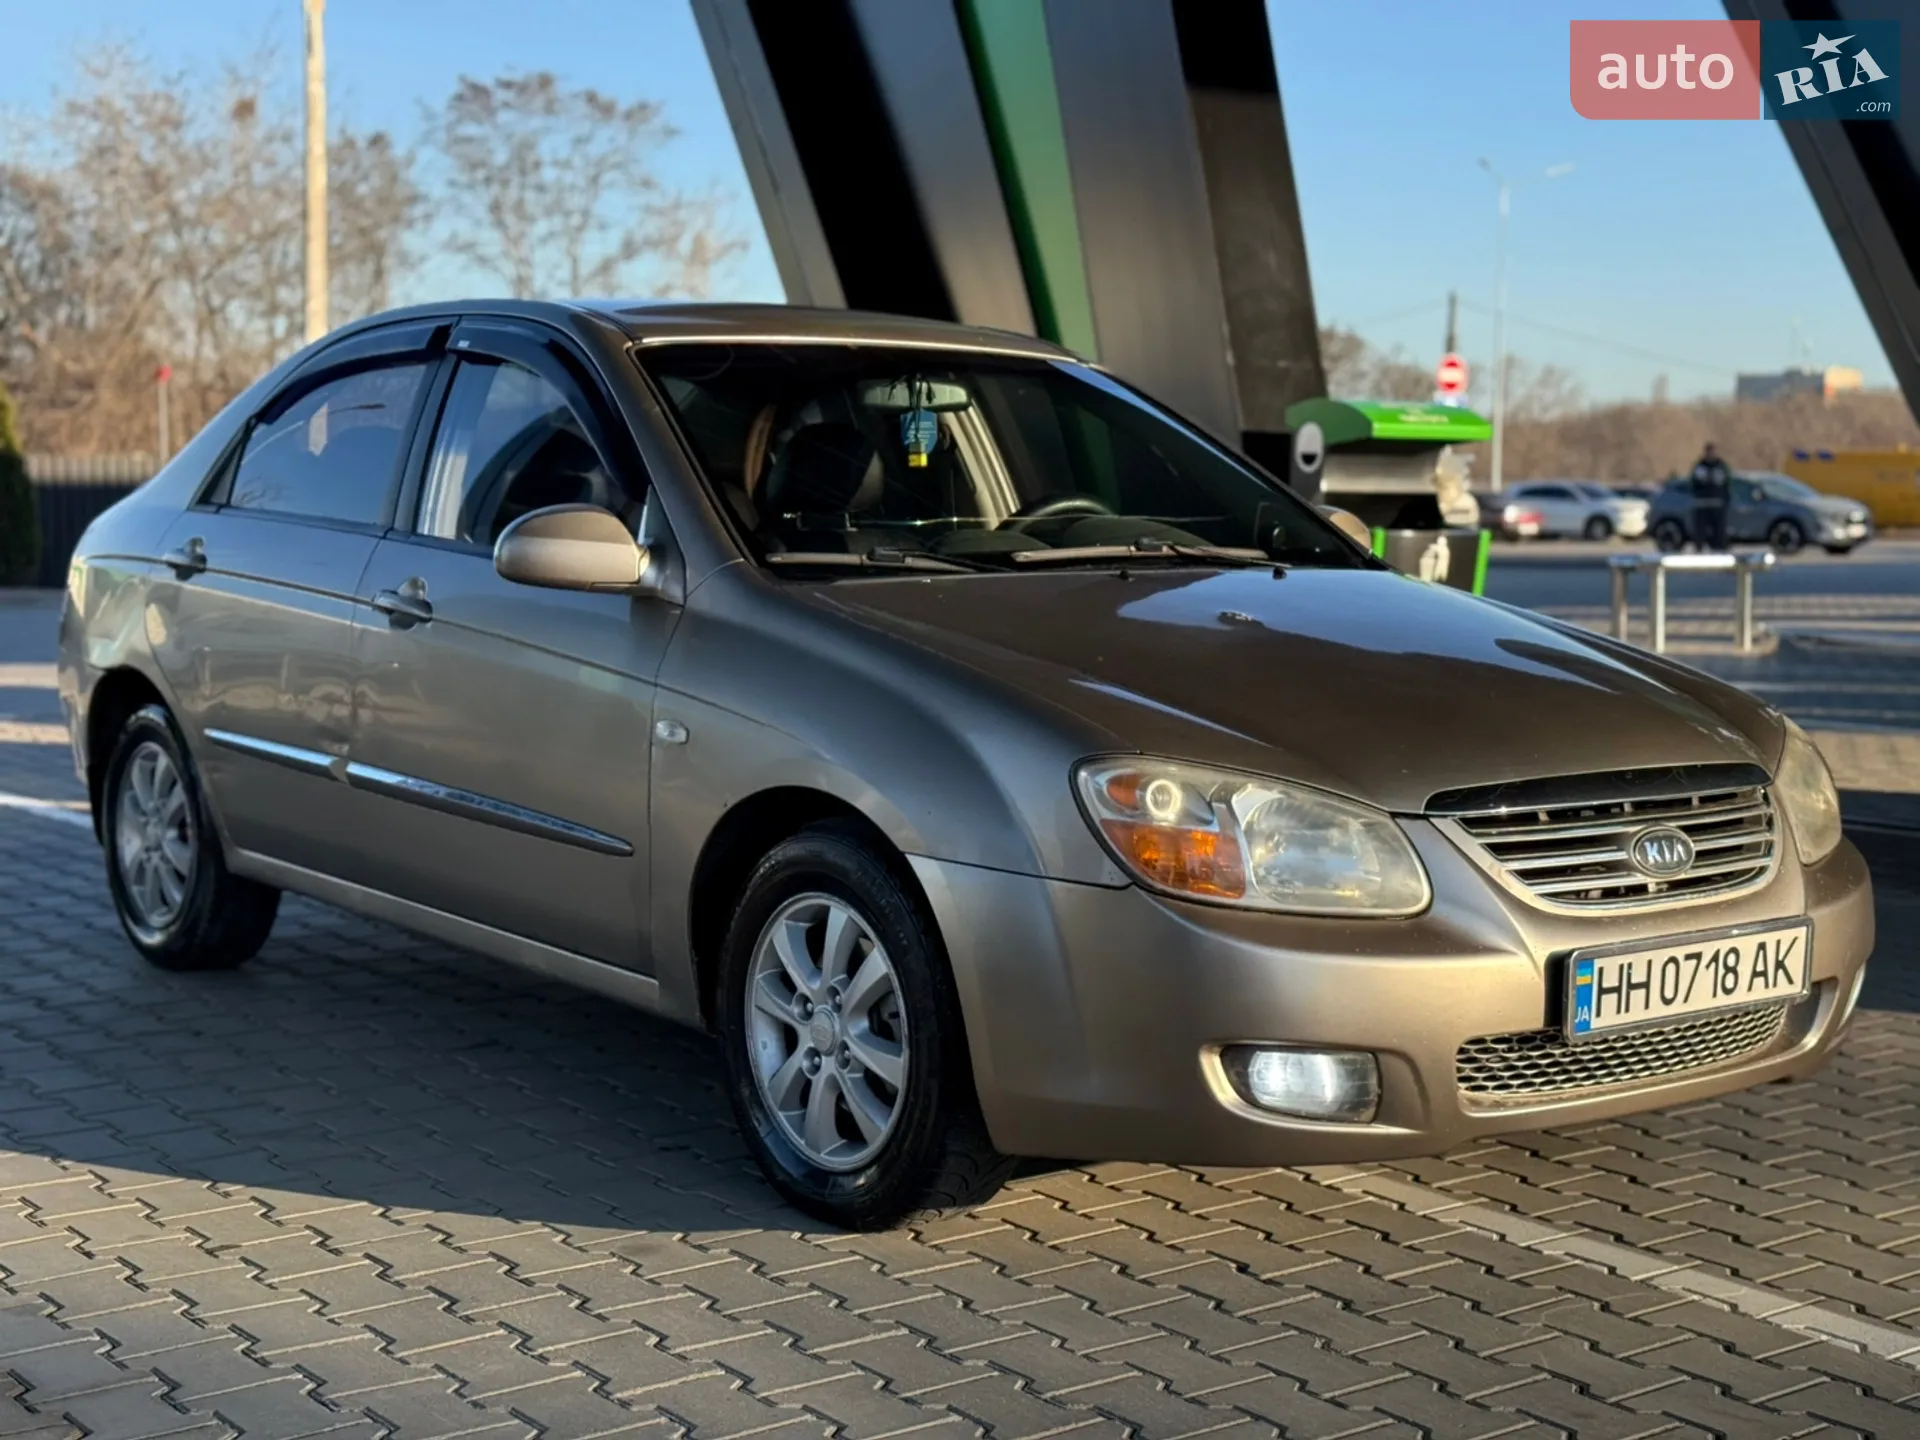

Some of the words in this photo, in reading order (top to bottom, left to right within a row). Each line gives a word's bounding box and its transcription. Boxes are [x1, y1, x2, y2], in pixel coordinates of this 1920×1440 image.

[1643, 838, 1688, 866] KIA
[1595, 959, 1652, 1019] HH
[1659, 946, 1741, 1007] 0718
[1747, 936, 1799, 992] AK
